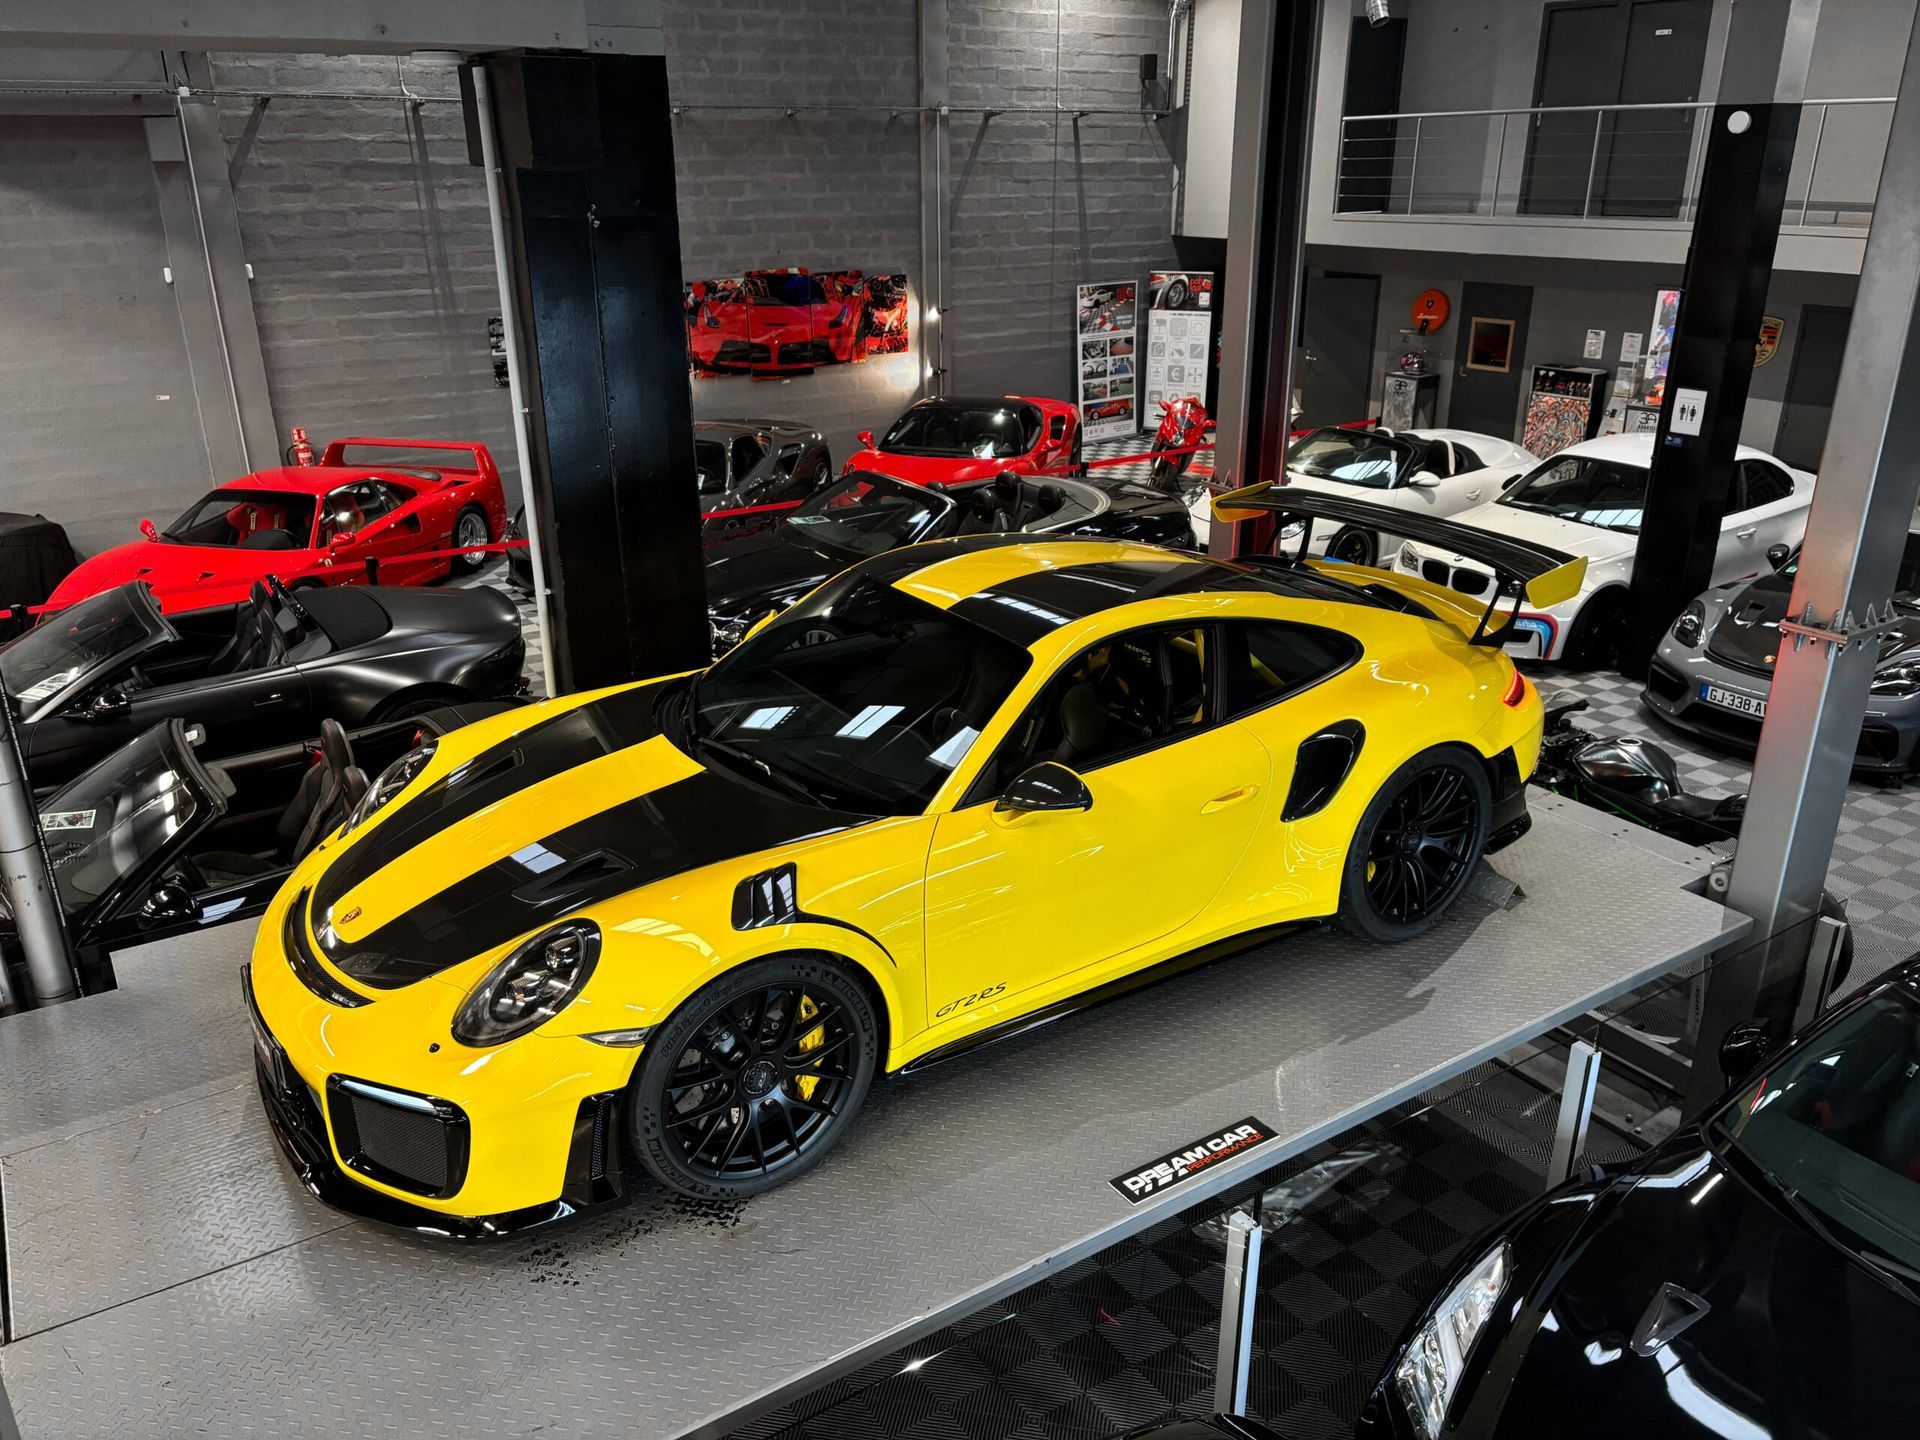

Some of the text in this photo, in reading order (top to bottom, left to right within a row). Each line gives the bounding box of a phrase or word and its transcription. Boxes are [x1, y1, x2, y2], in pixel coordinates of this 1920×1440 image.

[1122, 1124, 1258, 1193] DREAM CAR
[1186, 1132, 1264, 1173] PERFORMANCE
